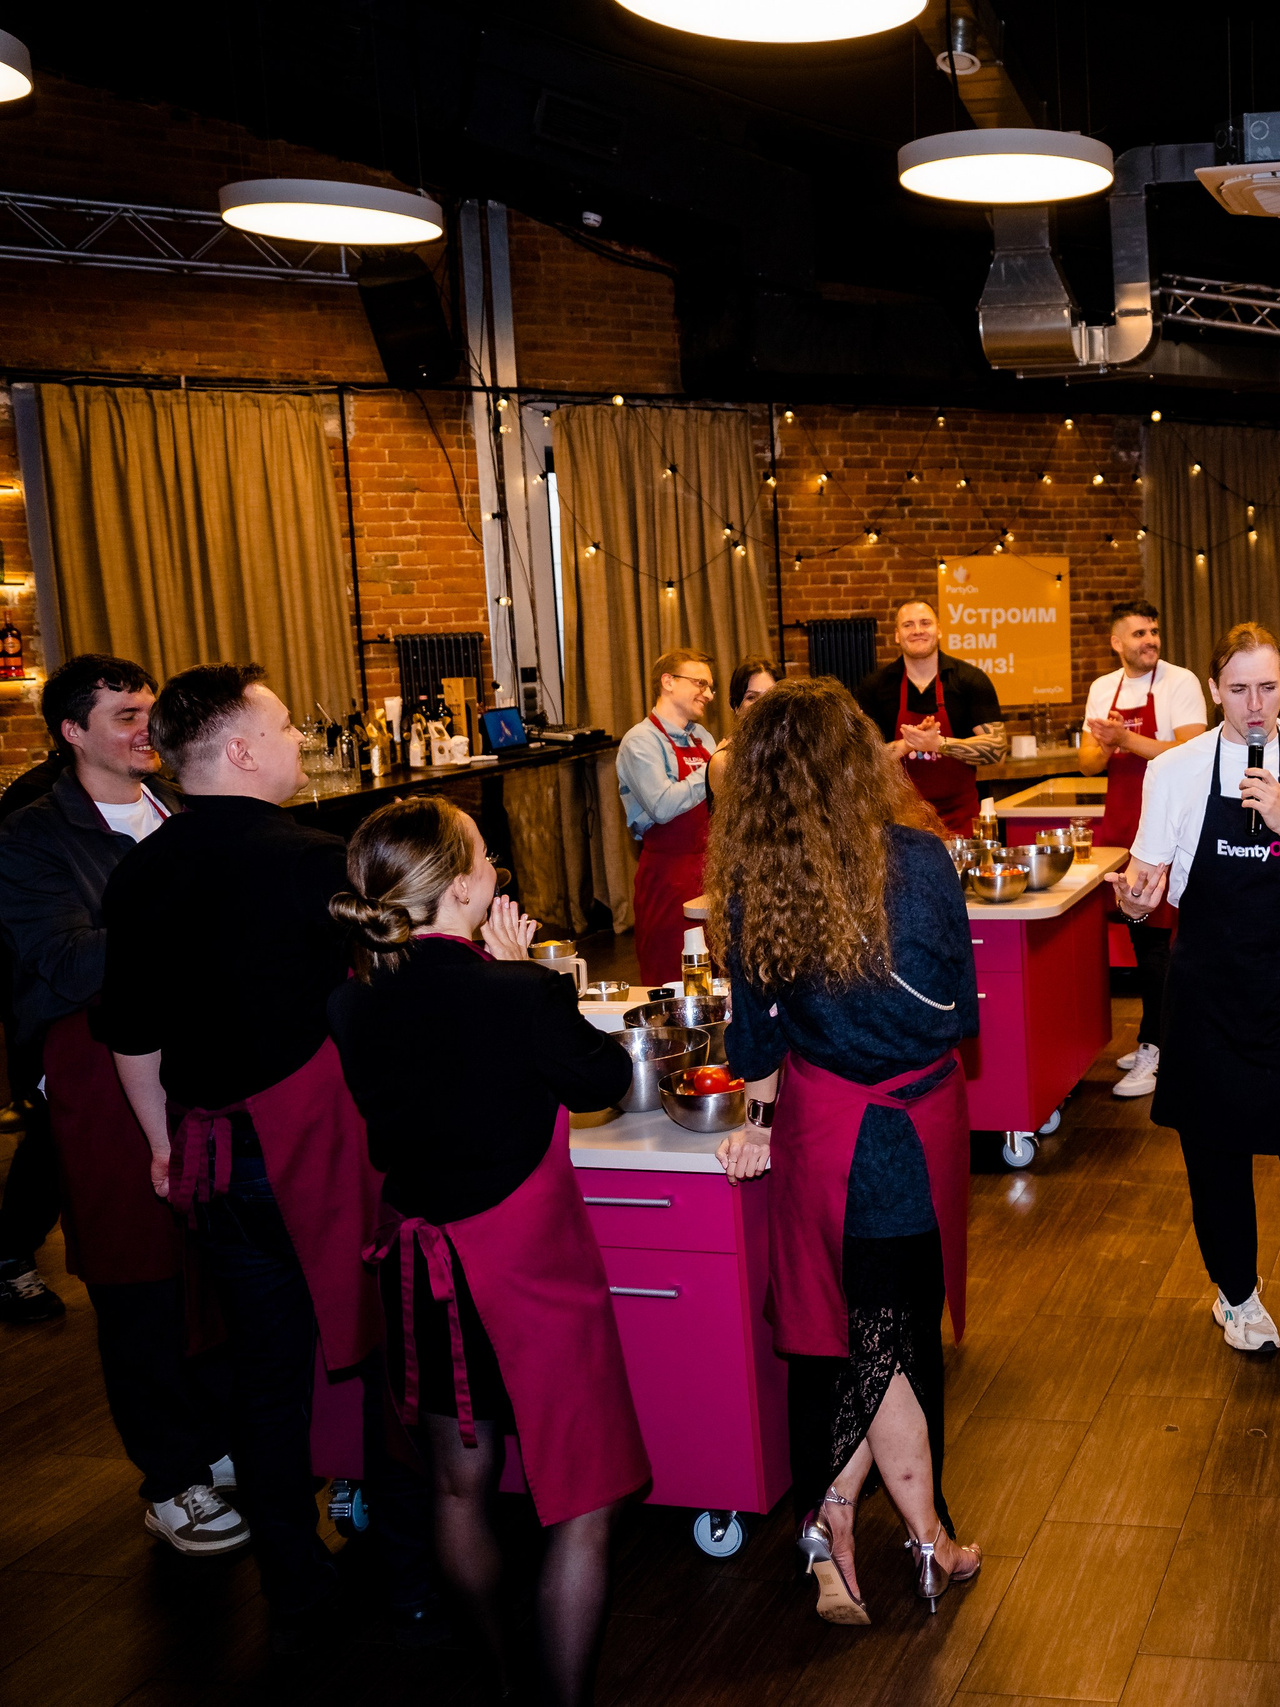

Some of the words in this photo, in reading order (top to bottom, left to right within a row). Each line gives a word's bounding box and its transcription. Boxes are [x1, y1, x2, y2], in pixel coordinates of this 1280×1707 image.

[948, 604, 1056, 629] Устроим
[948, 633, 996, 649] вам
[964, 653, 1014, 674] из!
